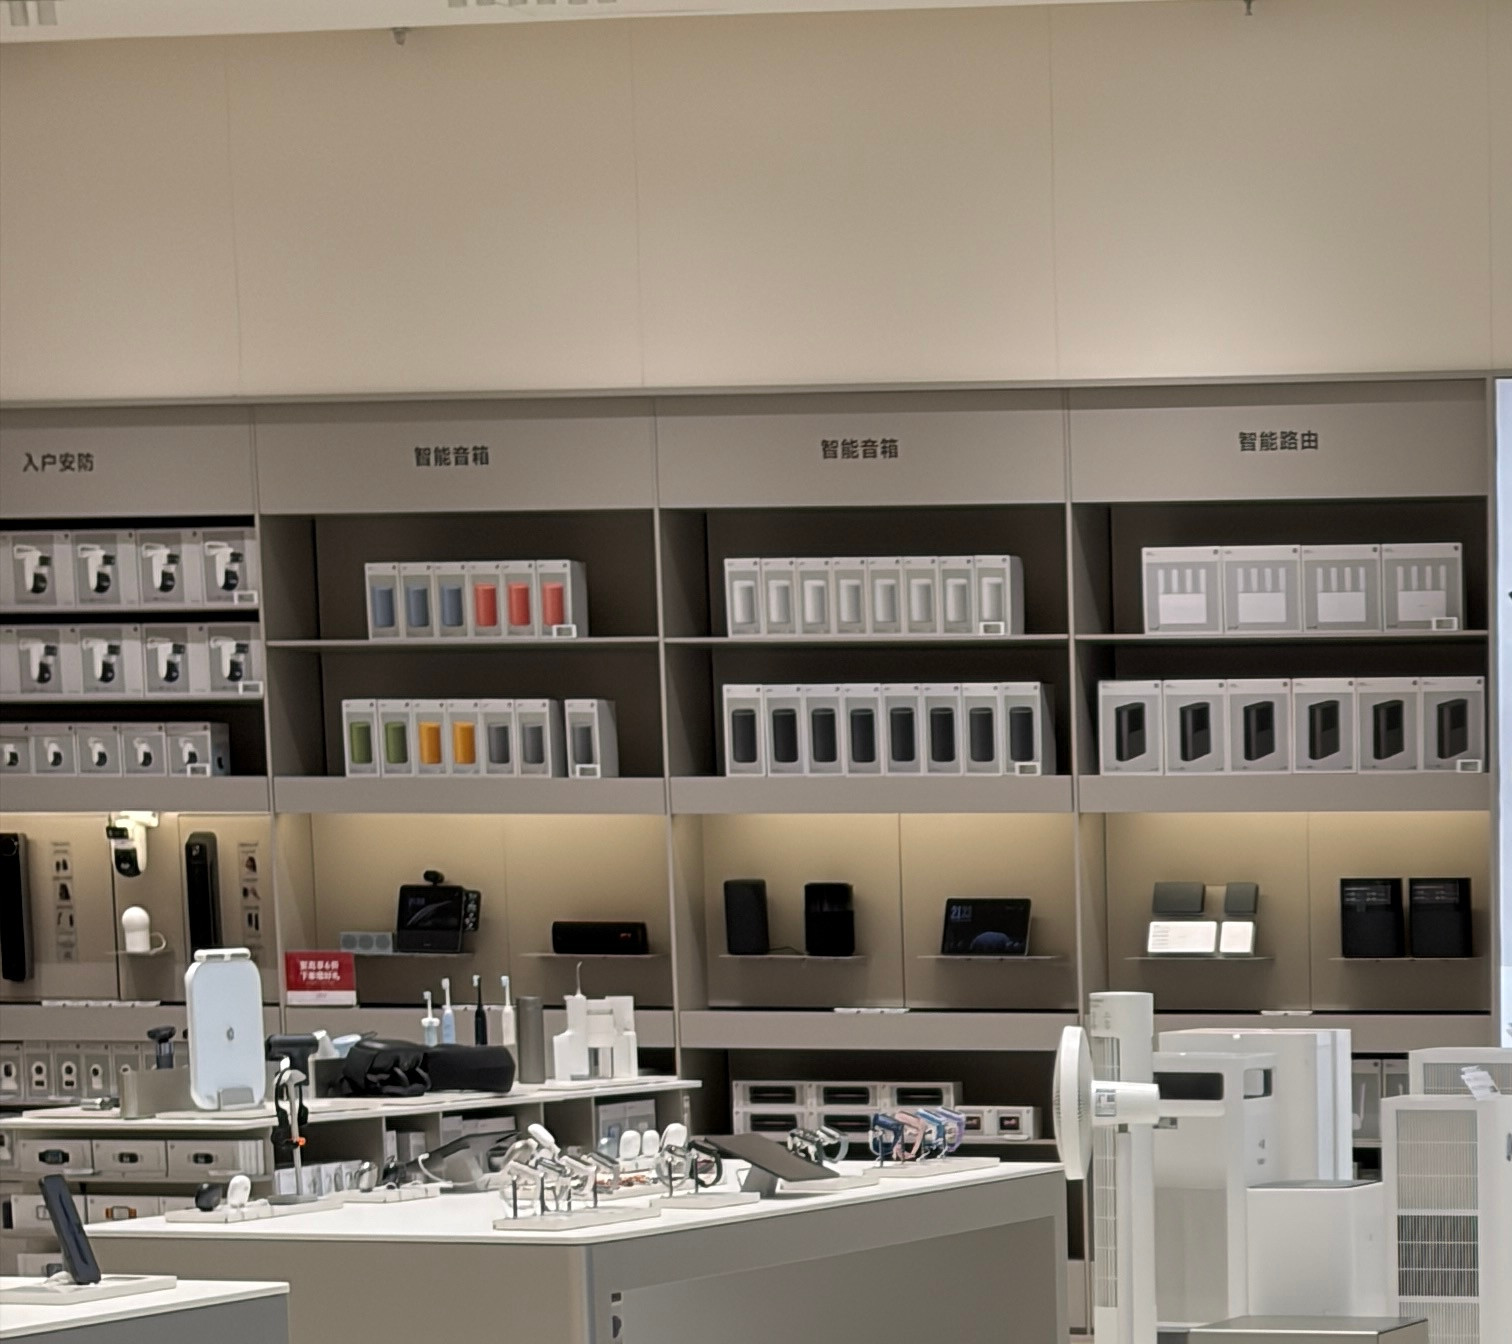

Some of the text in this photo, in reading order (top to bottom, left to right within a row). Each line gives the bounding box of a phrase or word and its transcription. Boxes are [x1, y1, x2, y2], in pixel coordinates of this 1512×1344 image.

[820, 437, 899, 461] 智能音箱
[1238, 430, 1319, 453] 智能路由
[22, 451, 94, 473] 入户安防
[413, 445, 490, 468] 智能音箱
